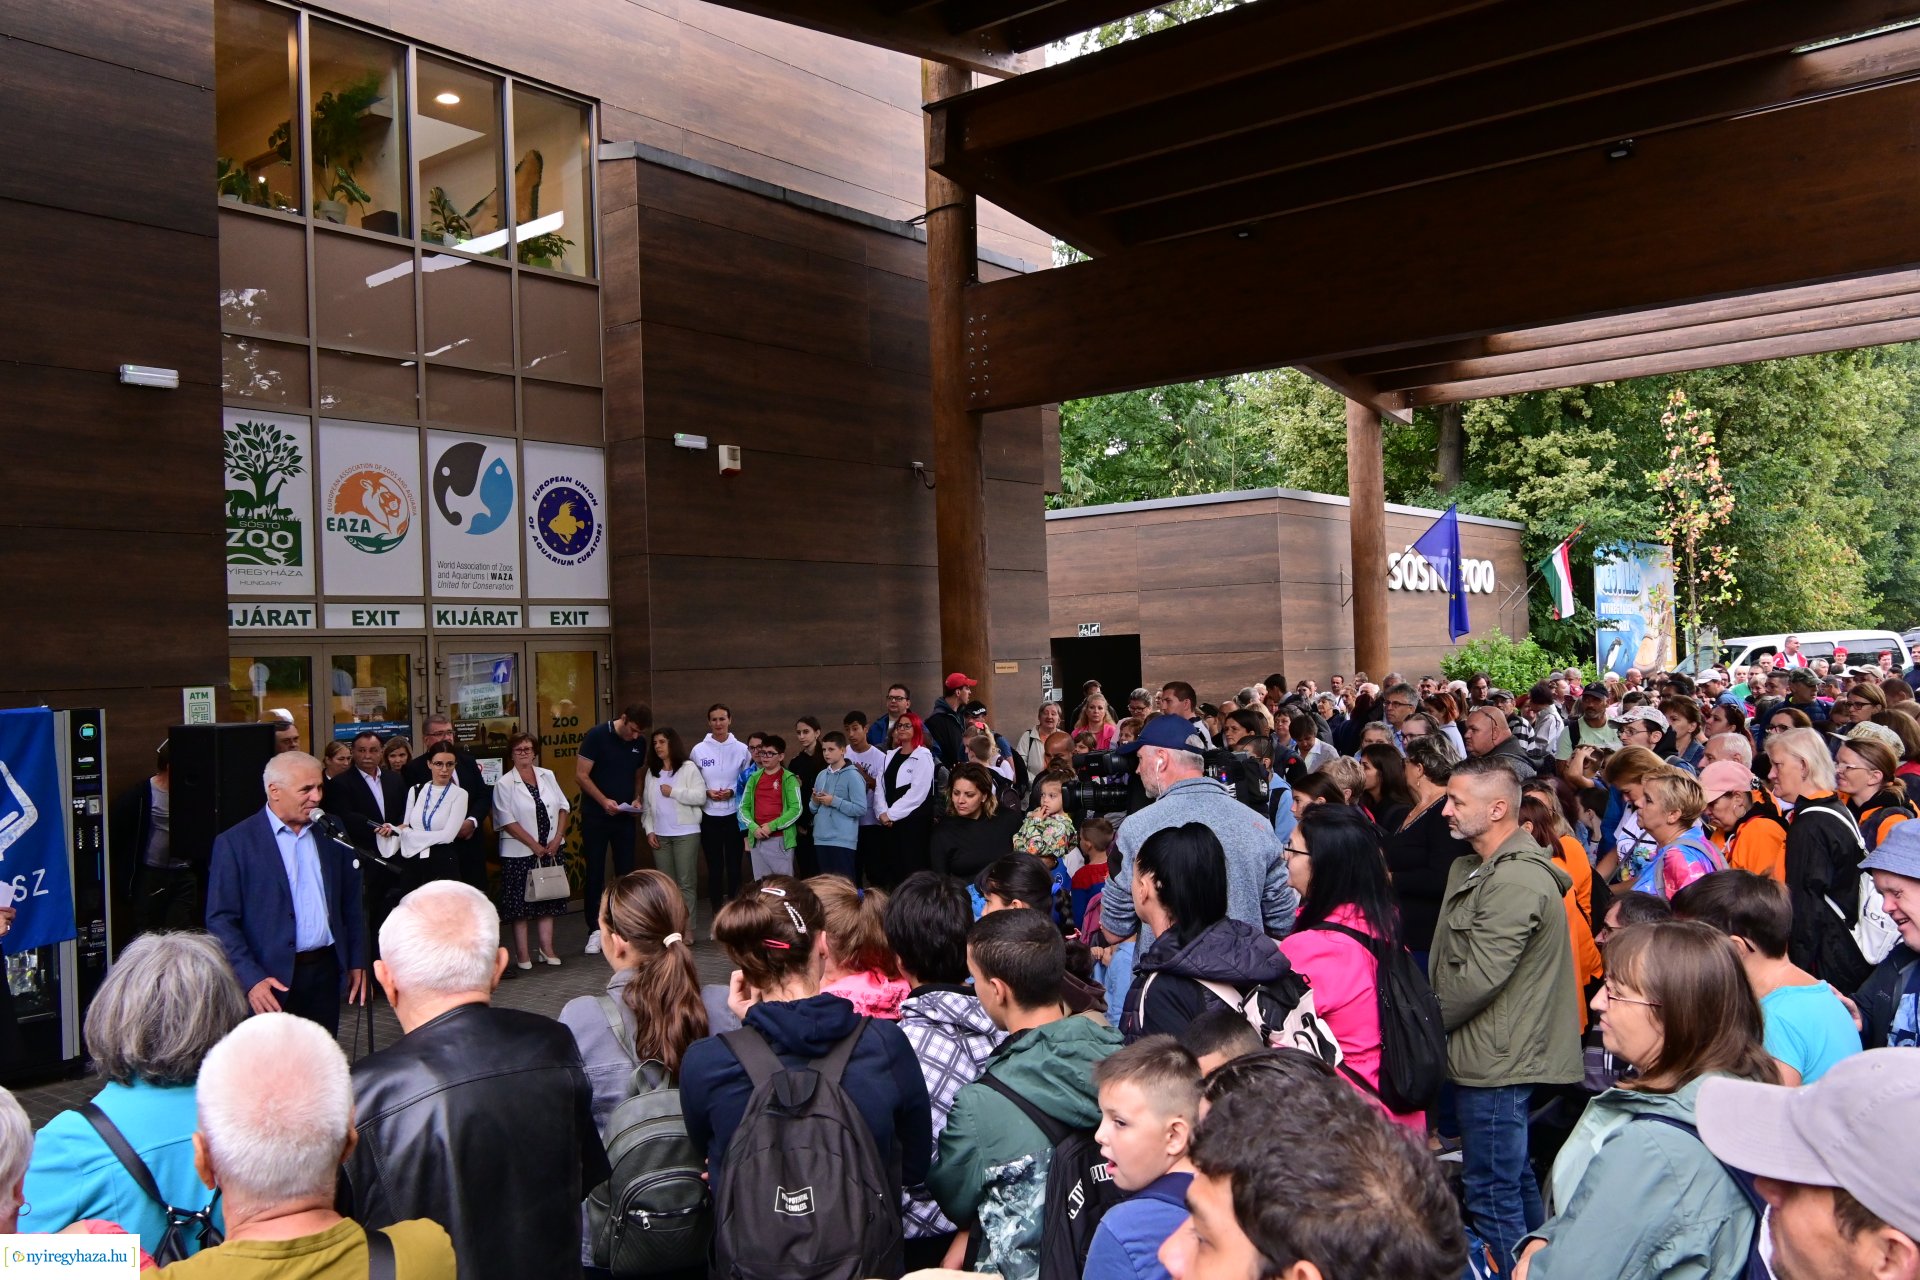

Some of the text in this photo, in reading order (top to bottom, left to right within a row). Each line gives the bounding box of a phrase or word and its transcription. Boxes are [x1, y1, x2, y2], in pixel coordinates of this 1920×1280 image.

[340, 463, 373, 481] ASSOCIATION
[383, 467, 397, 479] ZOOS
[532, 475, 598, 506] EUROPEAN UNION
[326, 517, 371, 533] EAZA
[226, 528, 294, 549] ZOO
[528, 516, 602, 566] OF AQUARIUM CURATORS
[226, 567, 304, 577] YÍREGYHÁZA
[437, 560, 513, 572] World Association of Zoos
[437, 571, 514, 582] and Aquariums WAZA
[1461, 558, 1494, 593] ZOO
[437, 580, 514, 590] United for Conservation
[228, 605, 312, 627] IJÁRAT
[352, 609, 400, 627] EXIT
[437, 607, 519, 626] KIJÁRAT
[550, 610, 589, 626] EXIT
[190, 691, 209, 700] ATM
[552, 716, 579, 728] ZOO
[540, 731, 588, 746] KIJÁRA
[554, 747, 578, 758] EXIT
